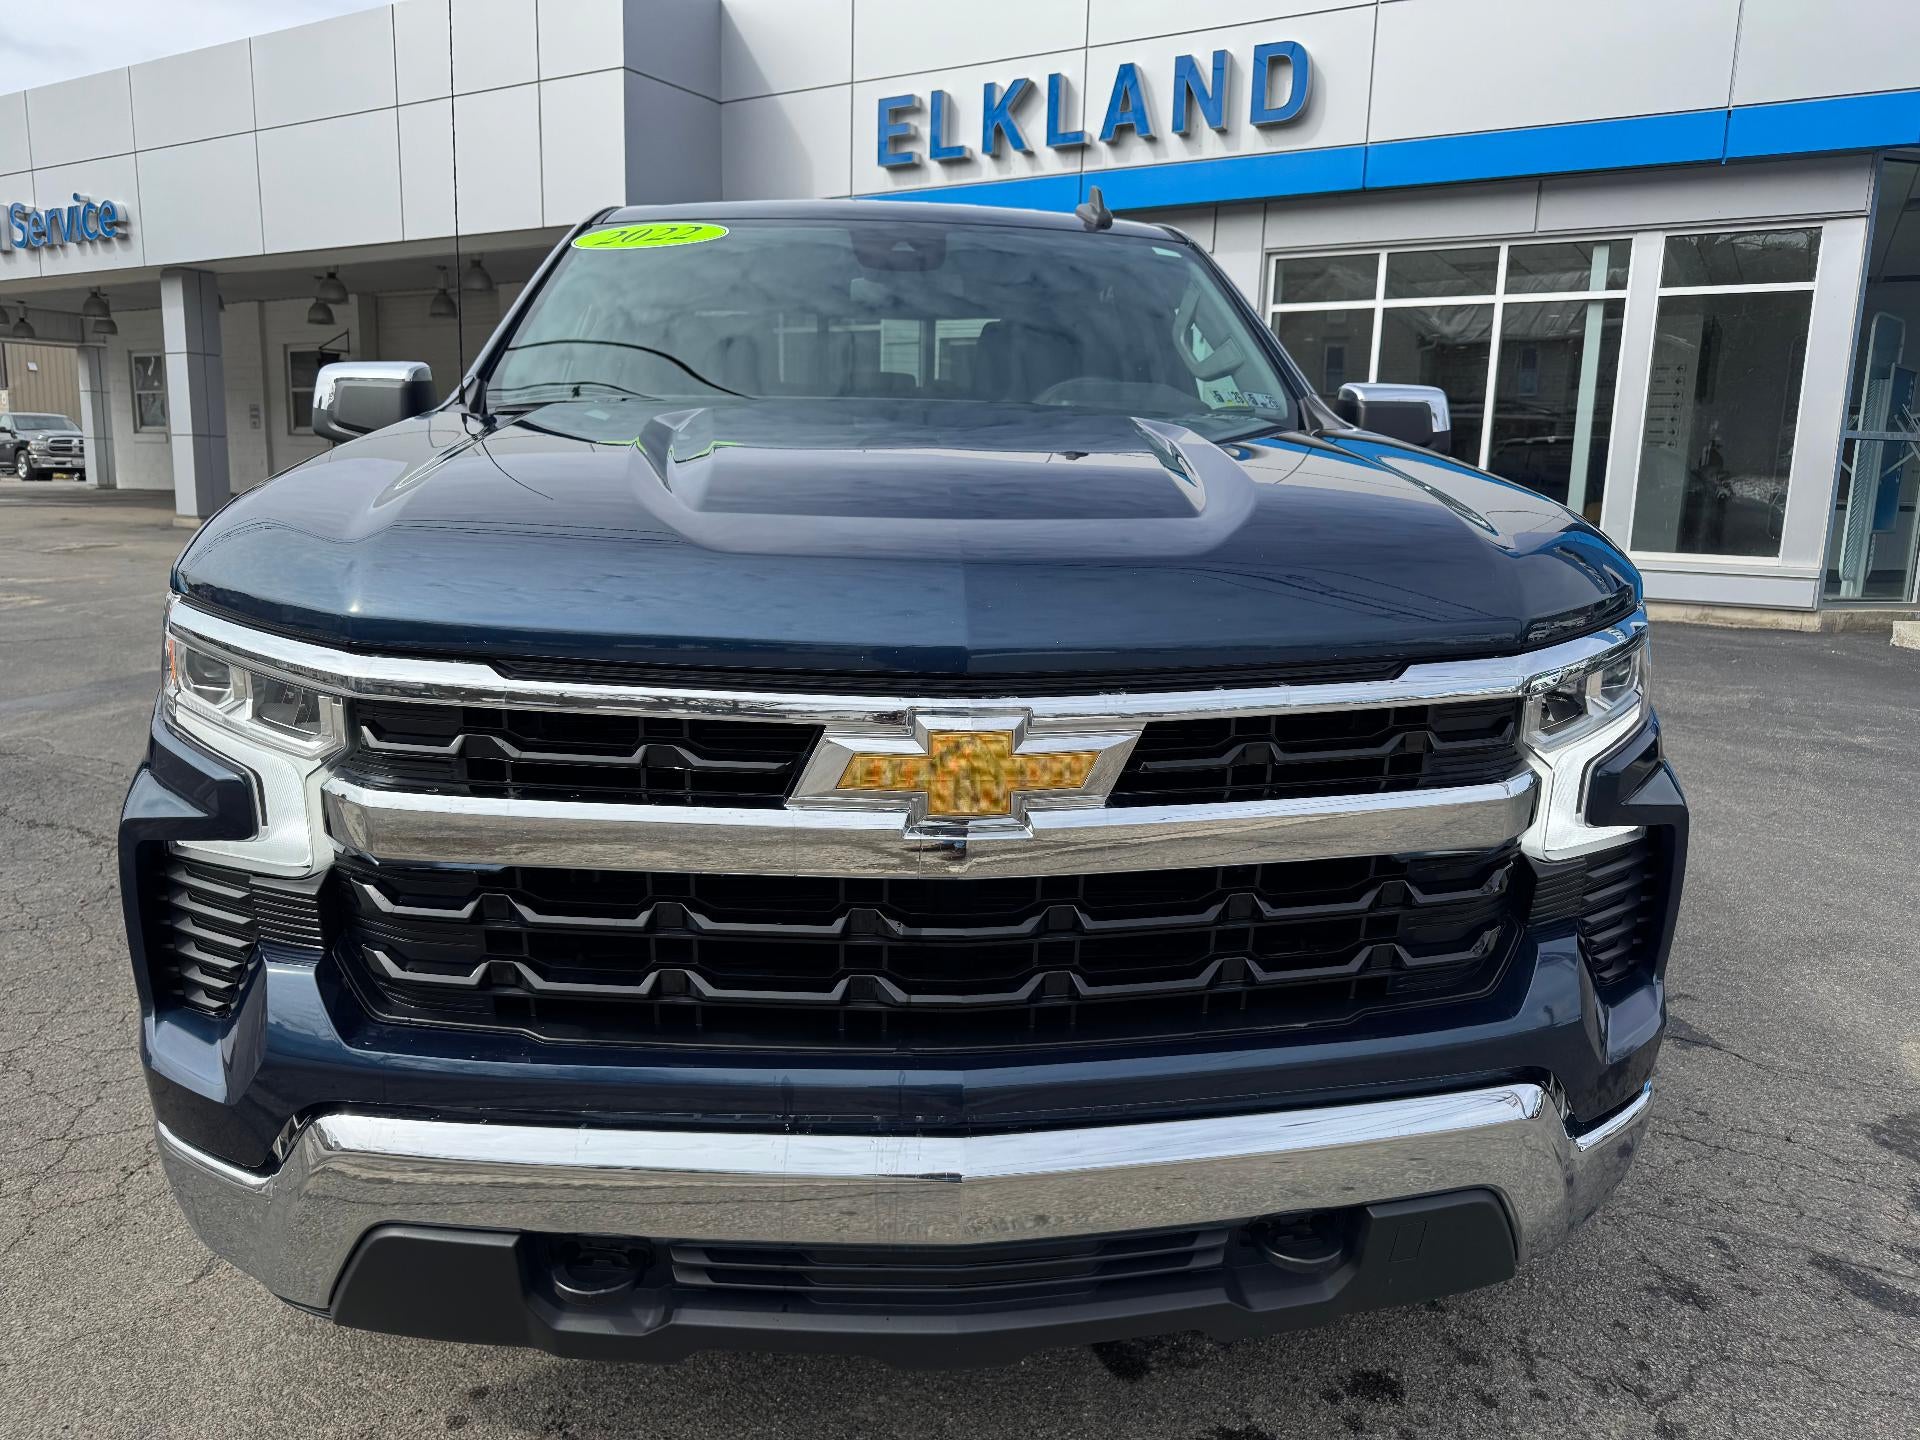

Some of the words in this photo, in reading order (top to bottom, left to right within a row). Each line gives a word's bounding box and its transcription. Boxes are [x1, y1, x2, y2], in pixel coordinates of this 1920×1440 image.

[877, 40, 1311, 167] ELKLAND
[9, 192, 118, 249] Service
[594, 226, 702, 246] 2022
